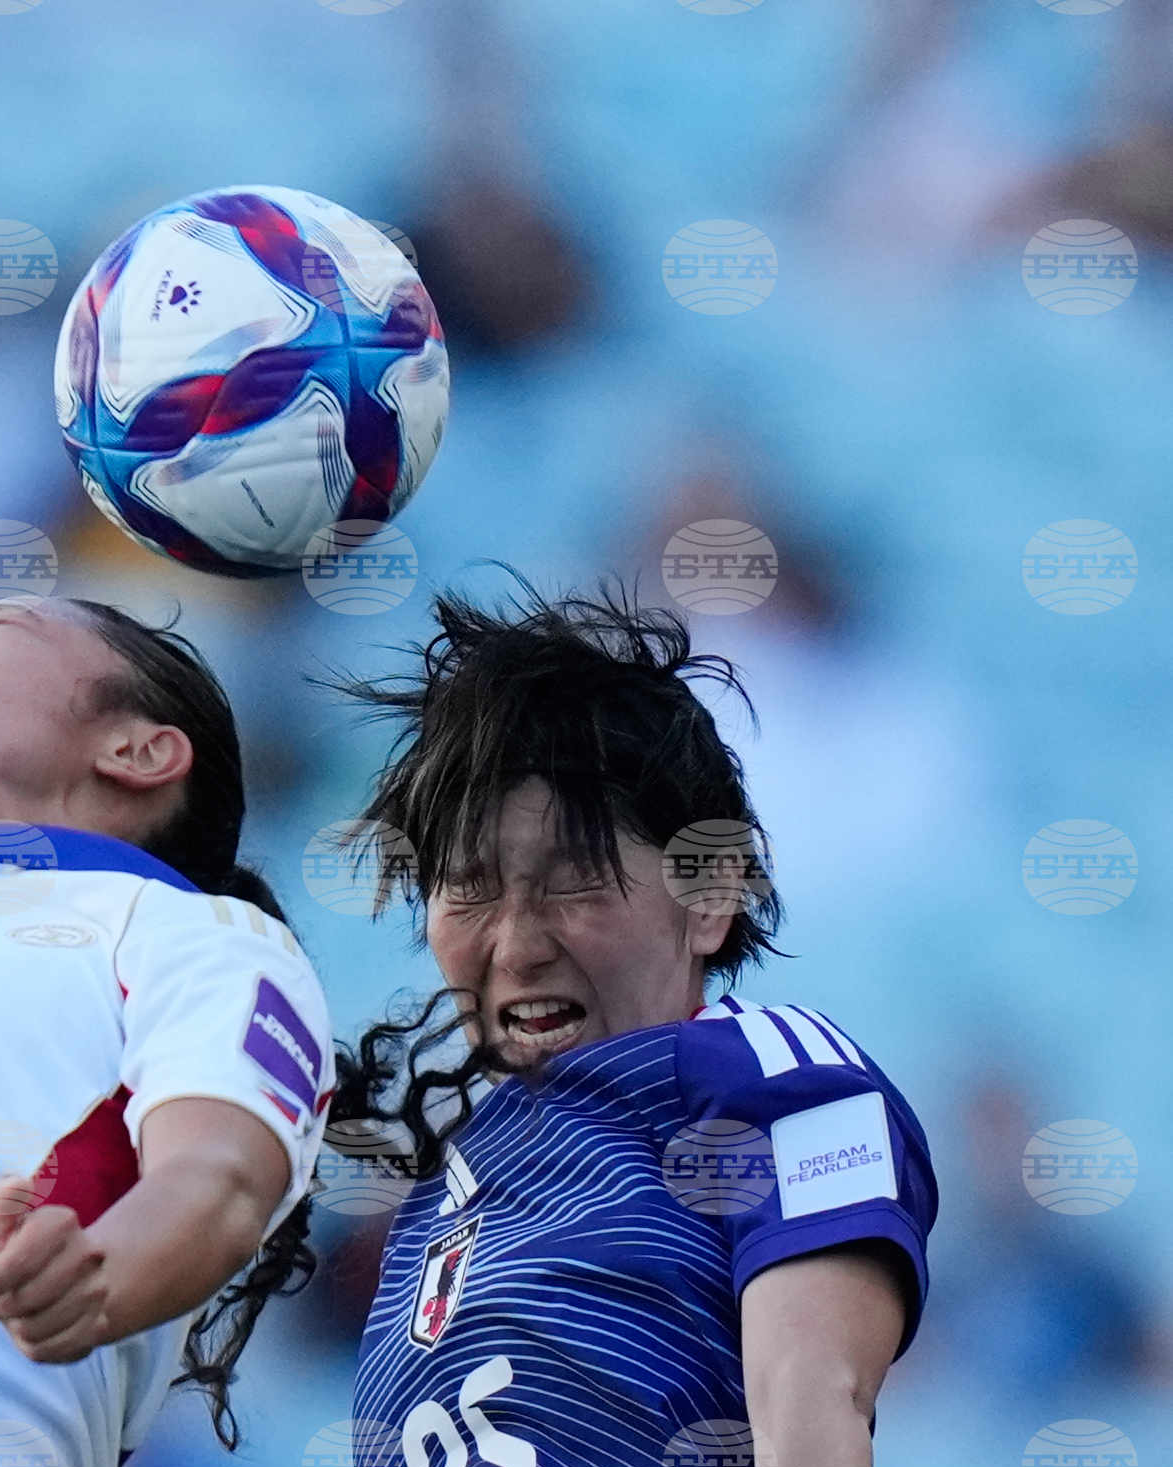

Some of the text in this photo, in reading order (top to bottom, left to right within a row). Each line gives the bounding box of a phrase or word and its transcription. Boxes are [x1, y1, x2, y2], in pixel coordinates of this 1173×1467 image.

[786, 1151, 884, 1187] FEARLESS
[798, 1143, 868, 1172] DREAM
[439, 1227, 470, 1253] JAPAN
